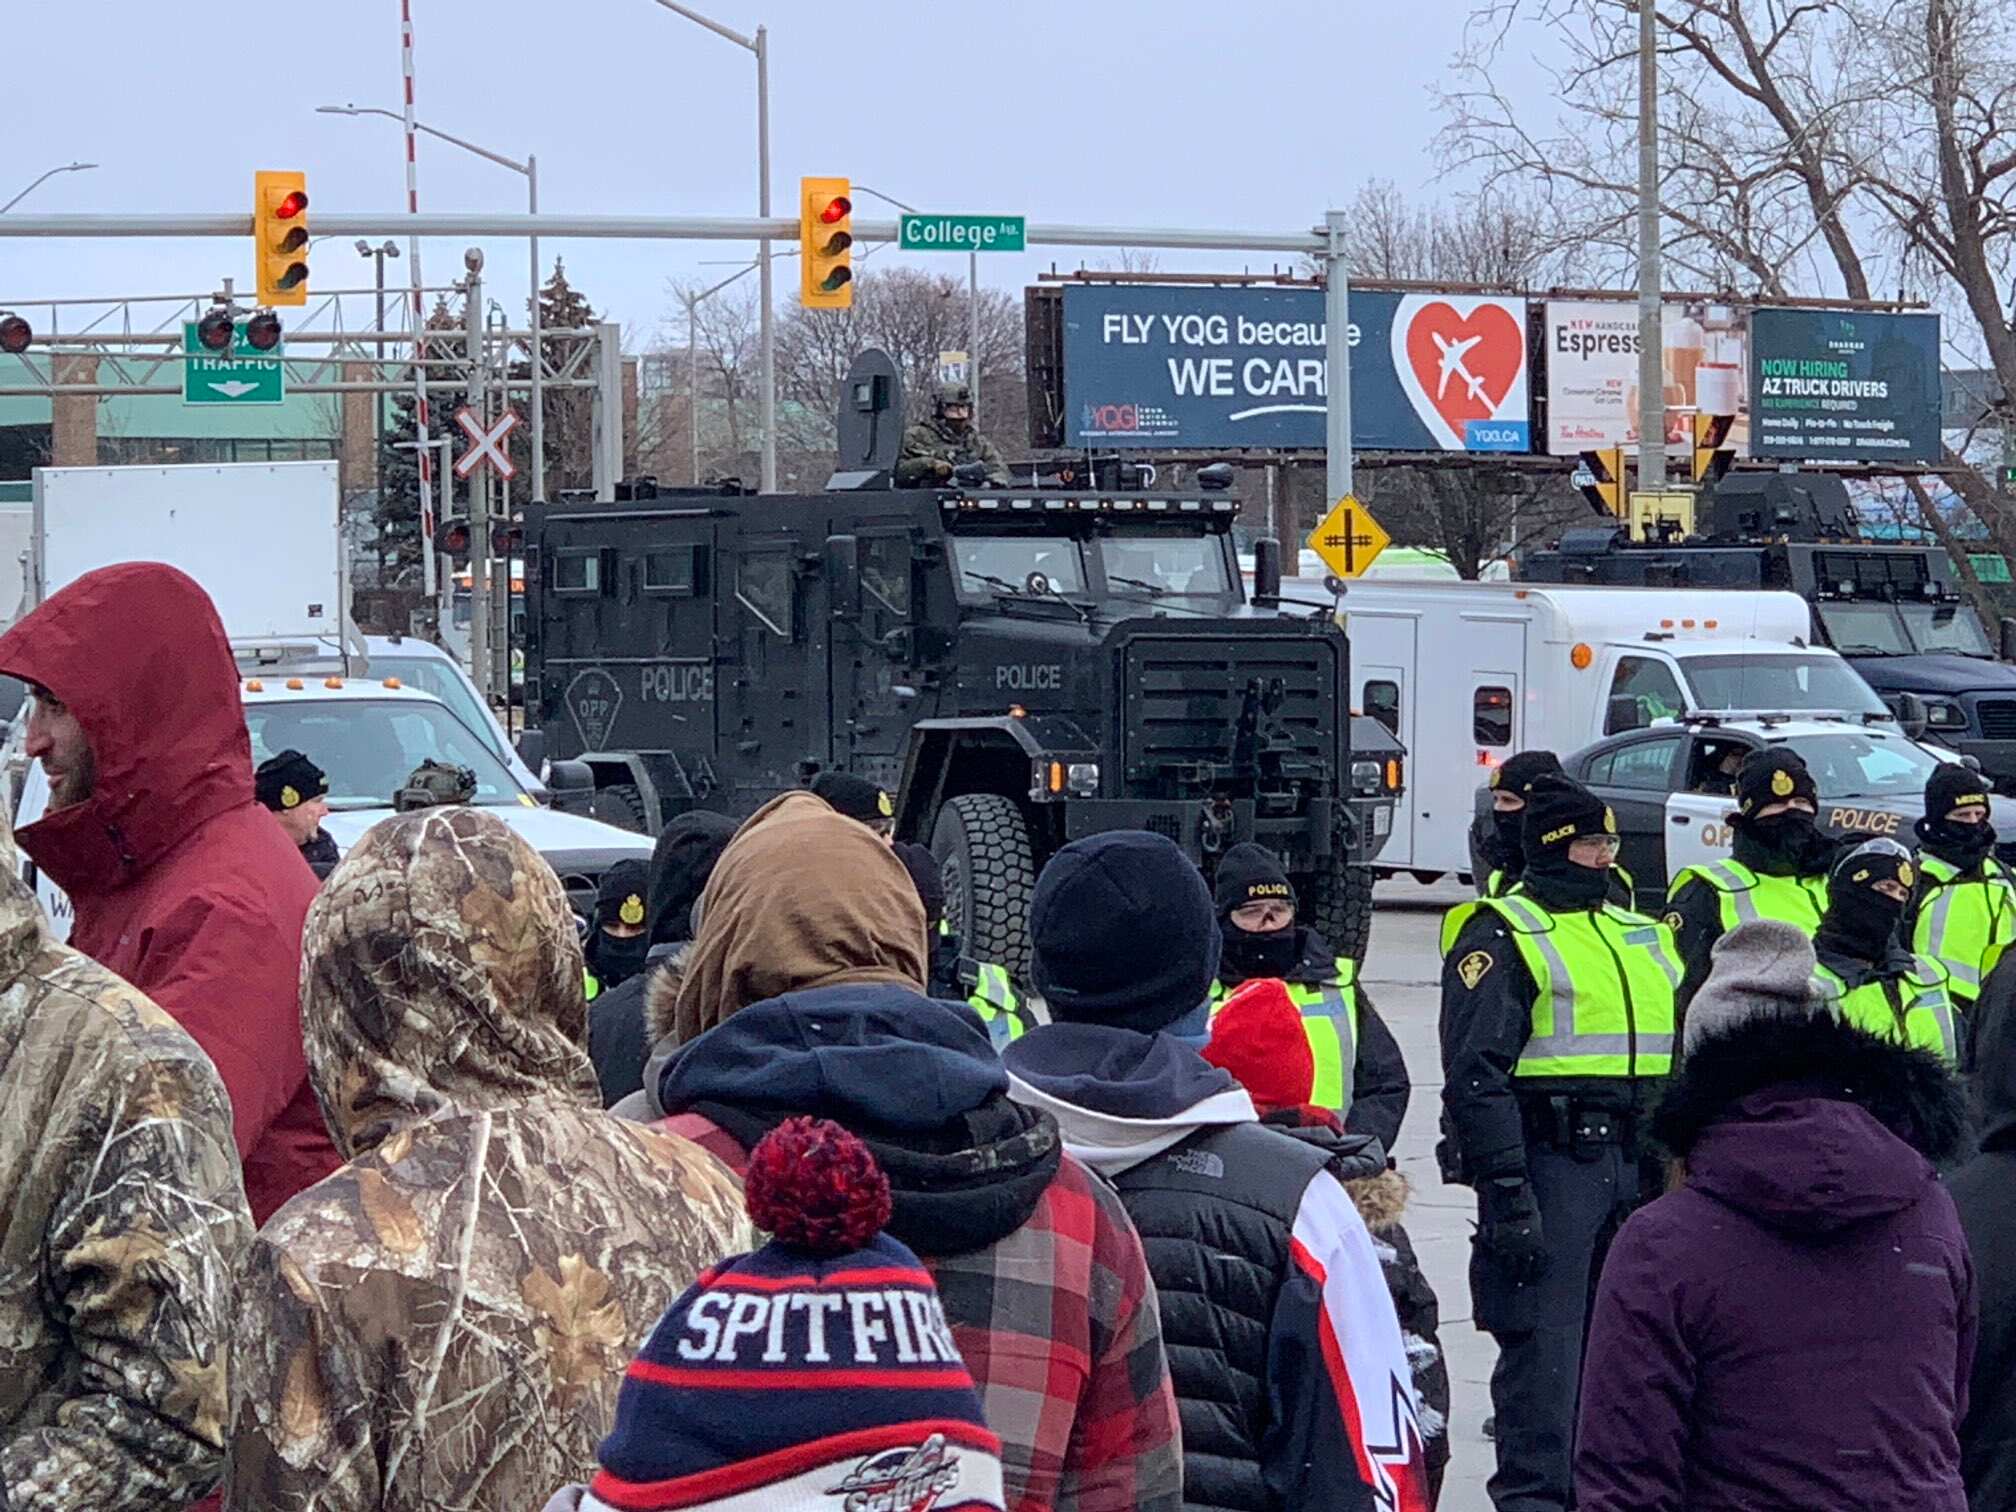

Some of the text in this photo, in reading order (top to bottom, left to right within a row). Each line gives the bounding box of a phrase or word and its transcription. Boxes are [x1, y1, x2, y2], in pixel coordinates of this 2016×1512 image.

[906, 219, 996, 249] College
[1103, 314, 1361, 346] FLY YQG becaue
[1556, 325, 1641, 361] Espress
[1167, 357, 1328, 396] WE CAR
[1761, 359, 1848, 378] NOW HIRING
[1762, 378, 1888, 398] AZ TRUCK DRIVERS
[641, 666, 714, 701] POLICE
[996, 664, 1061, 689] POLICE
[579, 699, 609, 718] OPP
[1828, 808, 1902, 834] POLICE
[1541, 824, 1576, 845] POLICE
[1248, 884, 1289, 897] POLICE
